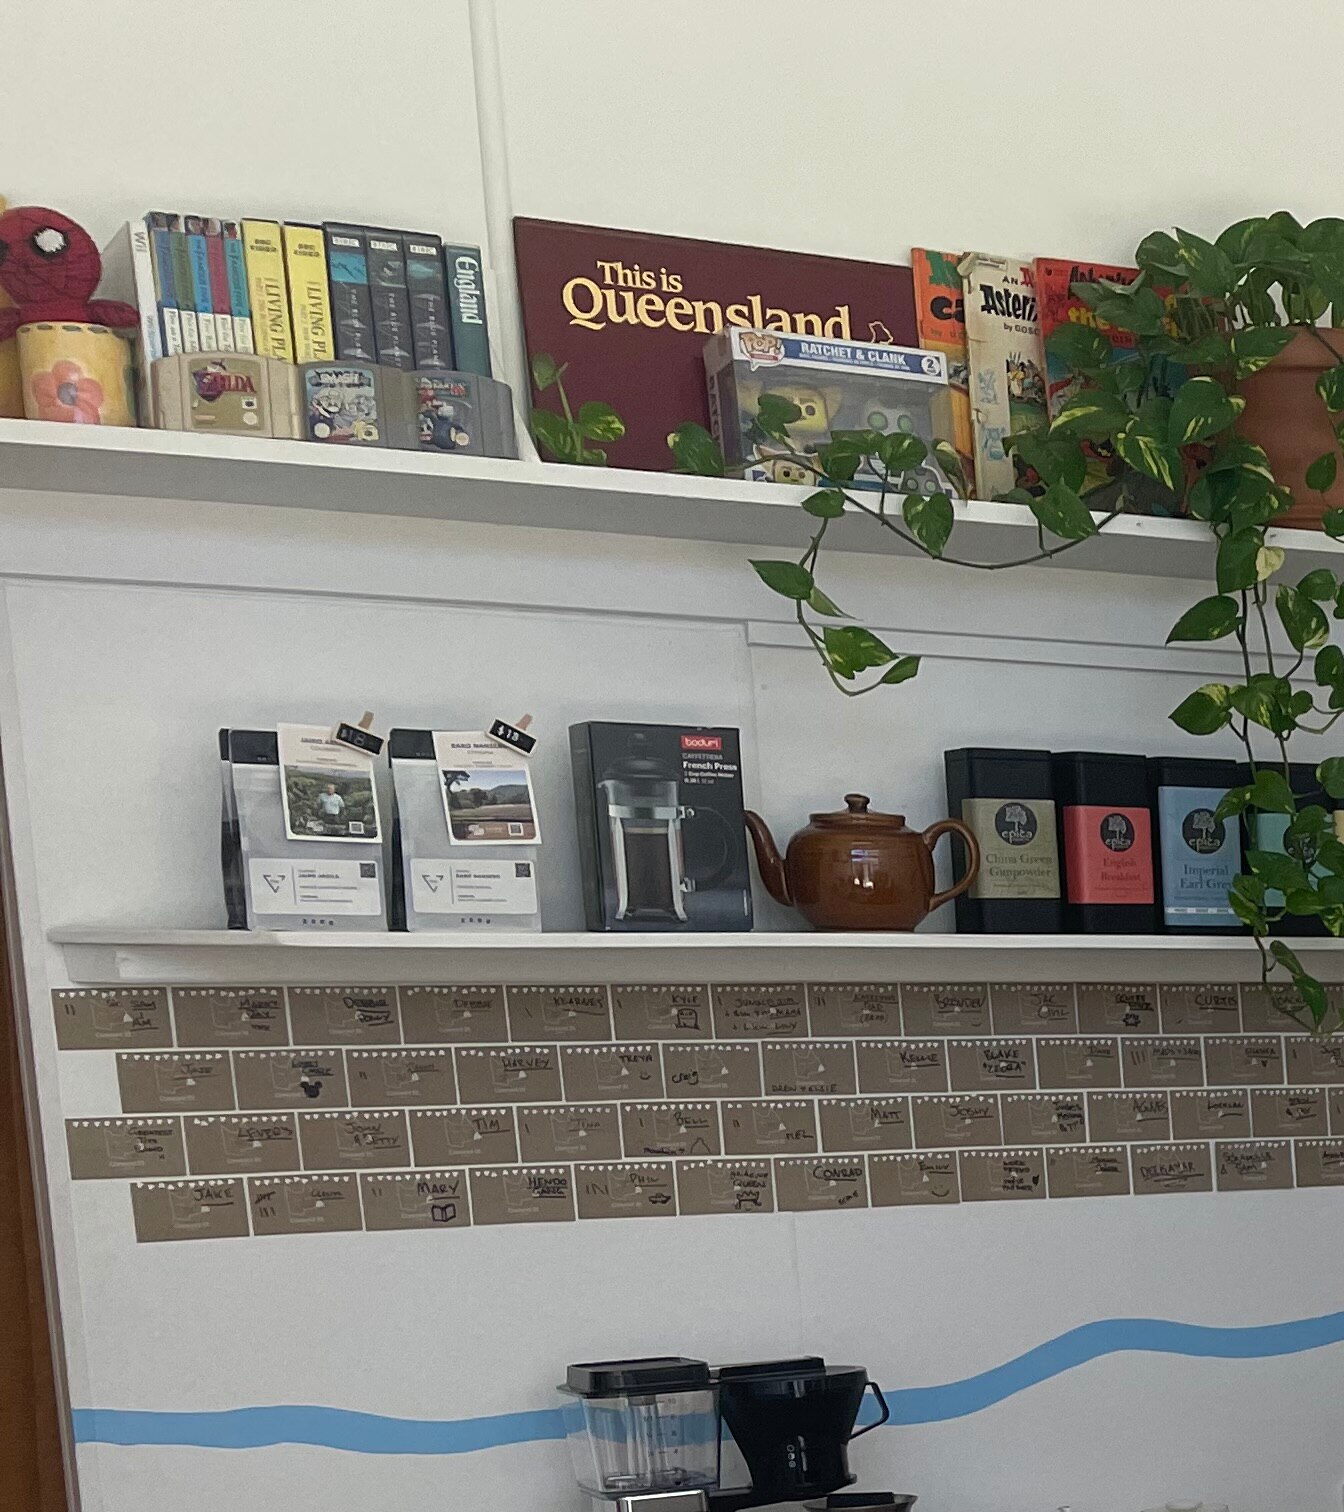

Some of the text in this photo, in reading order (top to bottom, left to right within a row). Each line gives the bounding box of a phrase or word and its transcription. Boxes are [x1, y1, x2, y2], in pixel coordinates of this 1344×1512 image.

[597, 260, 682, 293] This is
[1002, 275, 1018, 286] AN
[454, 256, 483, 325] England
[265, 284, 284, 334] LIVING
[307, 286, 325, 337] LIVING
[562, 277, 851, 341] Queensland
[801, 342, 851, 358] RATCHET
[856, 346, 865, 359] &
[868, 348, 907, 366] CLANK
[683, 761, 738, 771] French Press
[989, 866, 1052, 882] Gunpowder
[1184, 863, 1229, 879] Imperial
[1180, 879, 1204, 891] Earl
[472, 1118, 501, 1131] TIM
[418, 1180, 460, 1195] MARY
